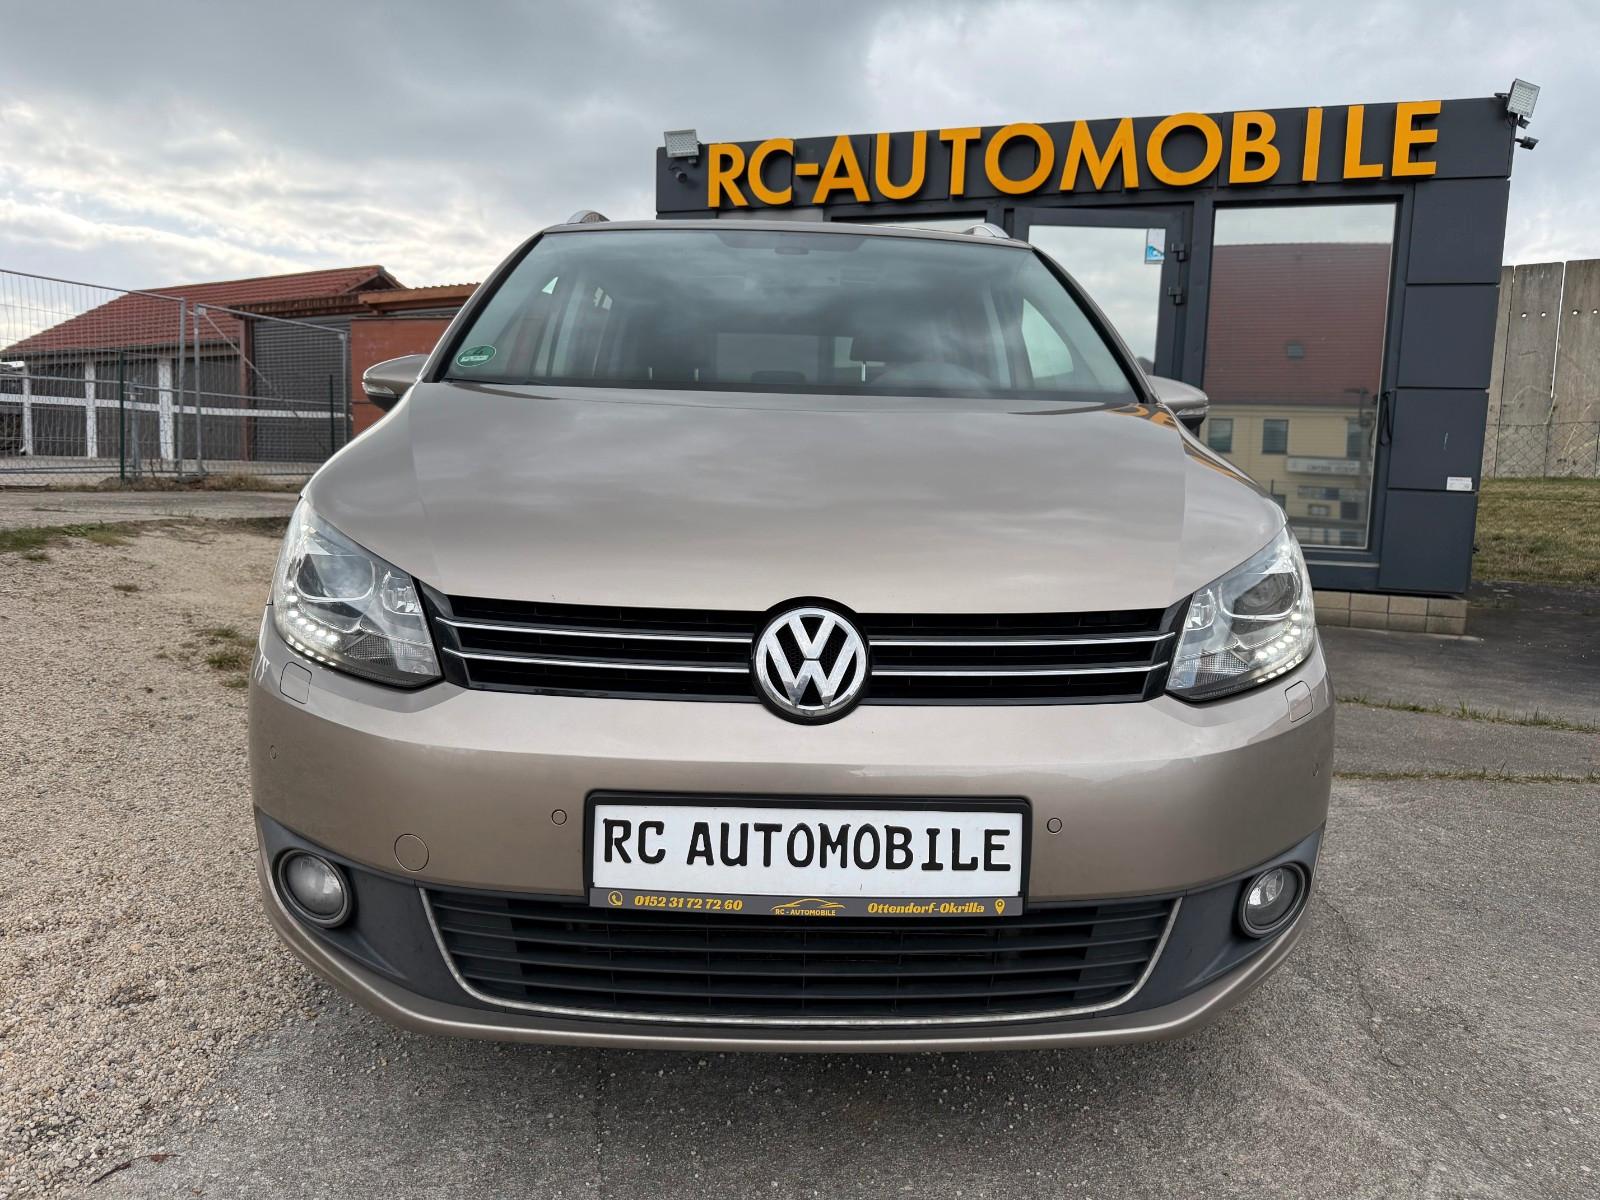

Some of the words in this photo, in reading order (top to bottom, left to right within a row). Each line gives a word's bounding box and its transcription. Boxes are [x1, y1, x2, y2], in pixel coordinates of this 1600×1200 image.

[707, 100, 1442, 208] RC-AUTOMOBILE
[756, 606, 867, 717] VW
[602, 818, 667, 865] RC
[686, 821, 1012, 872] AUTOMOBILE
[634, 895, 667, 907] 0152
[668, 897, 685, 909] 31
[686, 898, 703, 909] 72
[705, 898, 722, 910] 72
[724, 899, 743, 911] 60
[867, 901, 985, 914] Ottendorf-Okrilla
